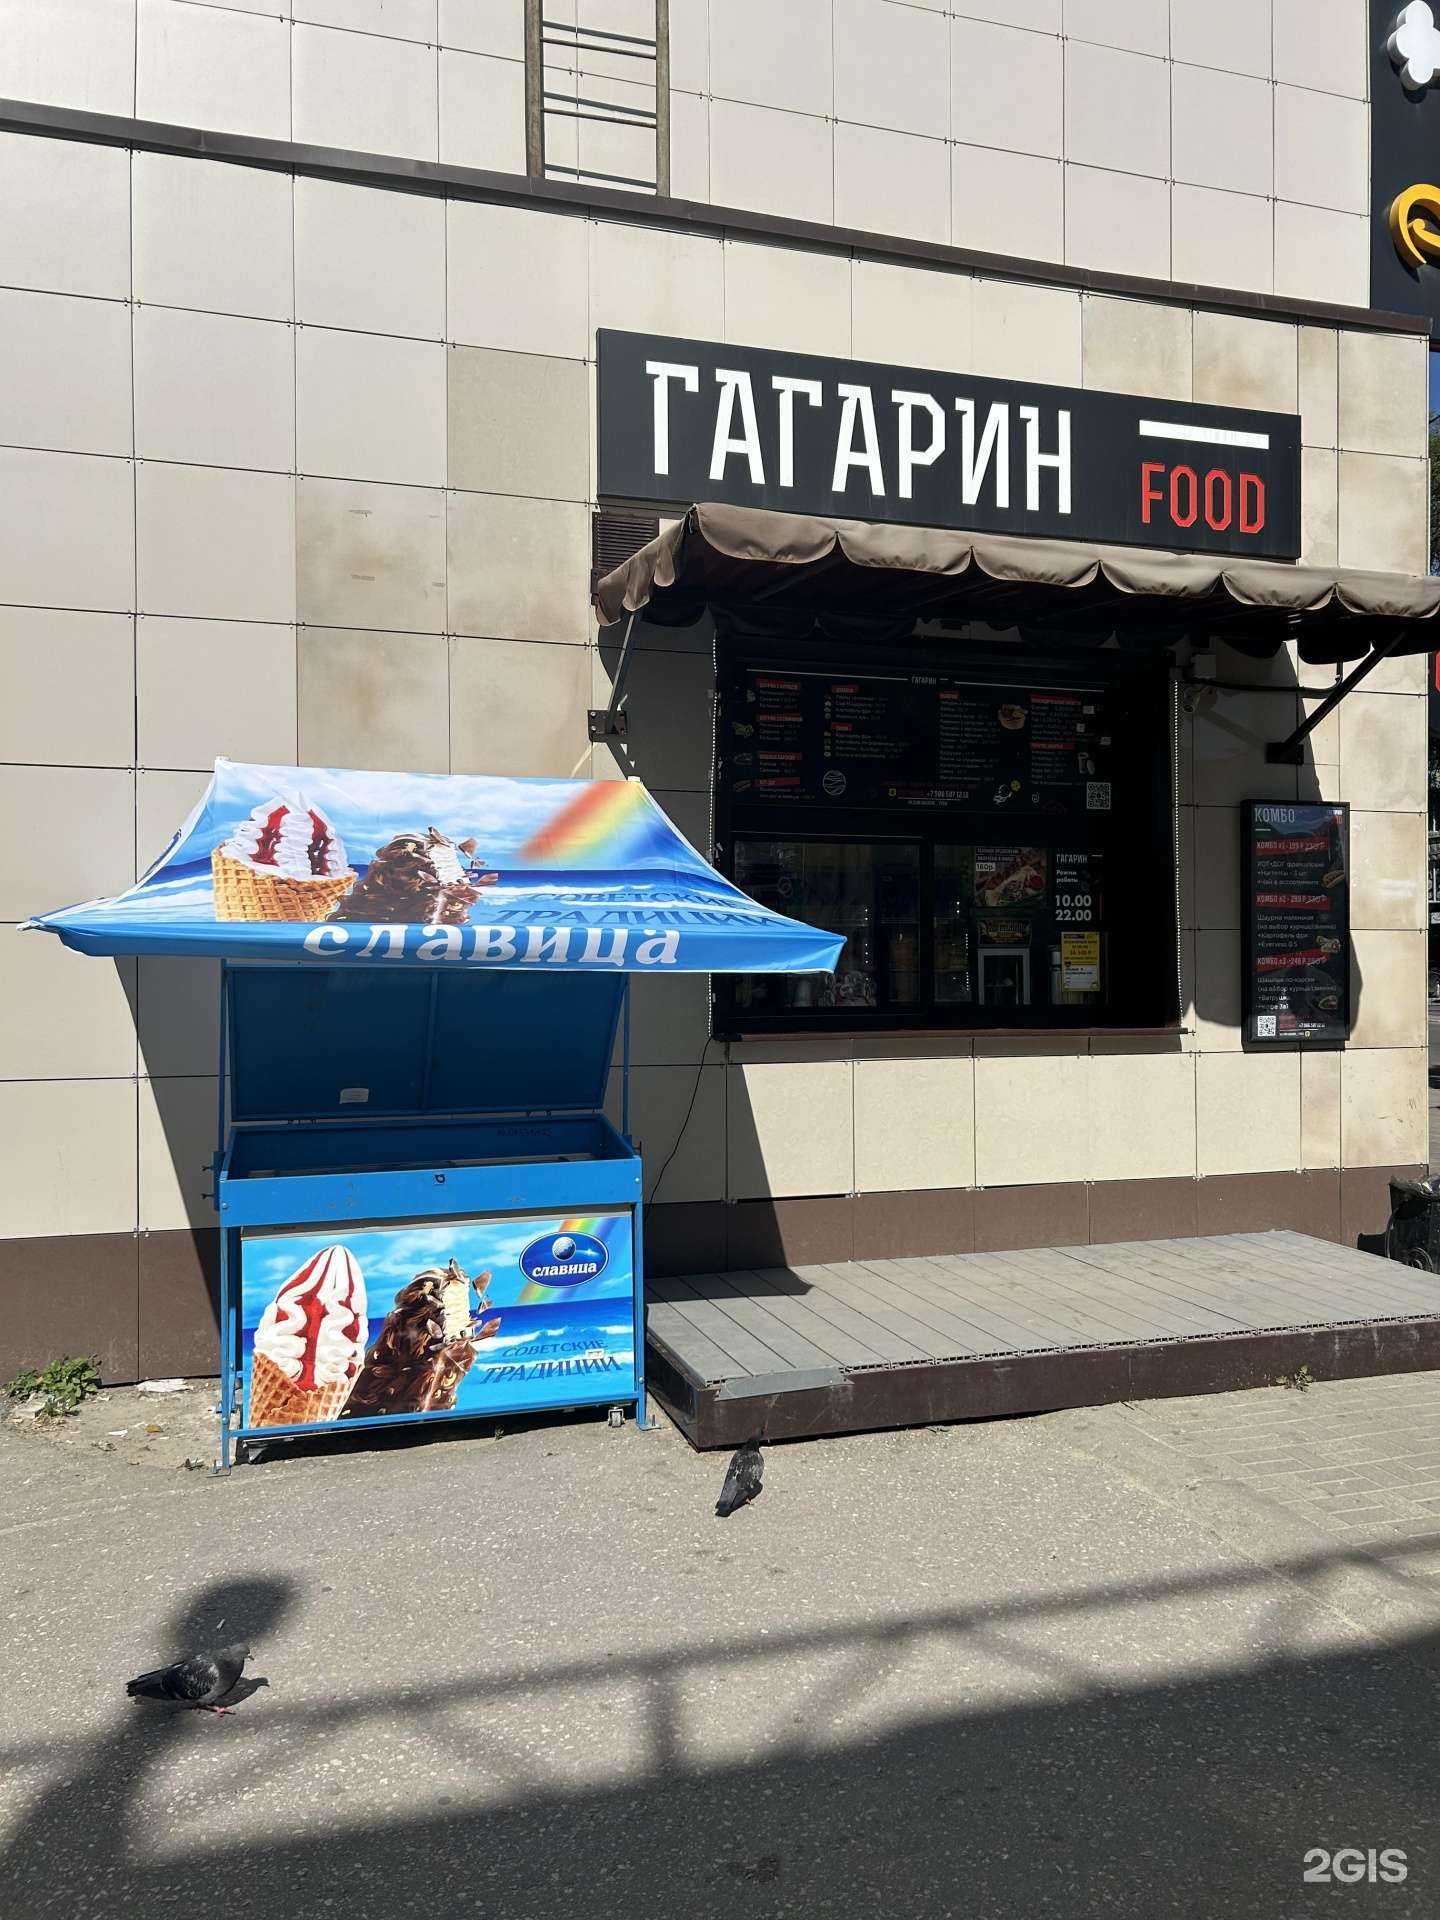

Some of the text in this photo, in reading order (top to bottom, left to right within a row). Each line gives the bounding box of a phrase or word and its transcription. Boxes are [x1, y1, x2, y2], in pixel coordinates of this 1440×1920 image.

[646, 360, 1072, 514] ГАГАРИН
[1138, 461, 1266, 534] FOOD
[1254, 807, 1296, 823] КОМБО
[1056, 853, 1088, 864] ГАГАРИН
[524, 892, 736, 909] СОВЕТСКИЕ
[1055, 894, 1092, 907] 10.00
[1055, 909, 1092, 921] 22.00
[303, 923, 681, 967] славица
[532, 1262, 598, 1278] славица
[502, 1337, 609, 1358] СОВЕТСКИЕ
[479, 1356, 624, 1385] ТРАДИЦИИ
